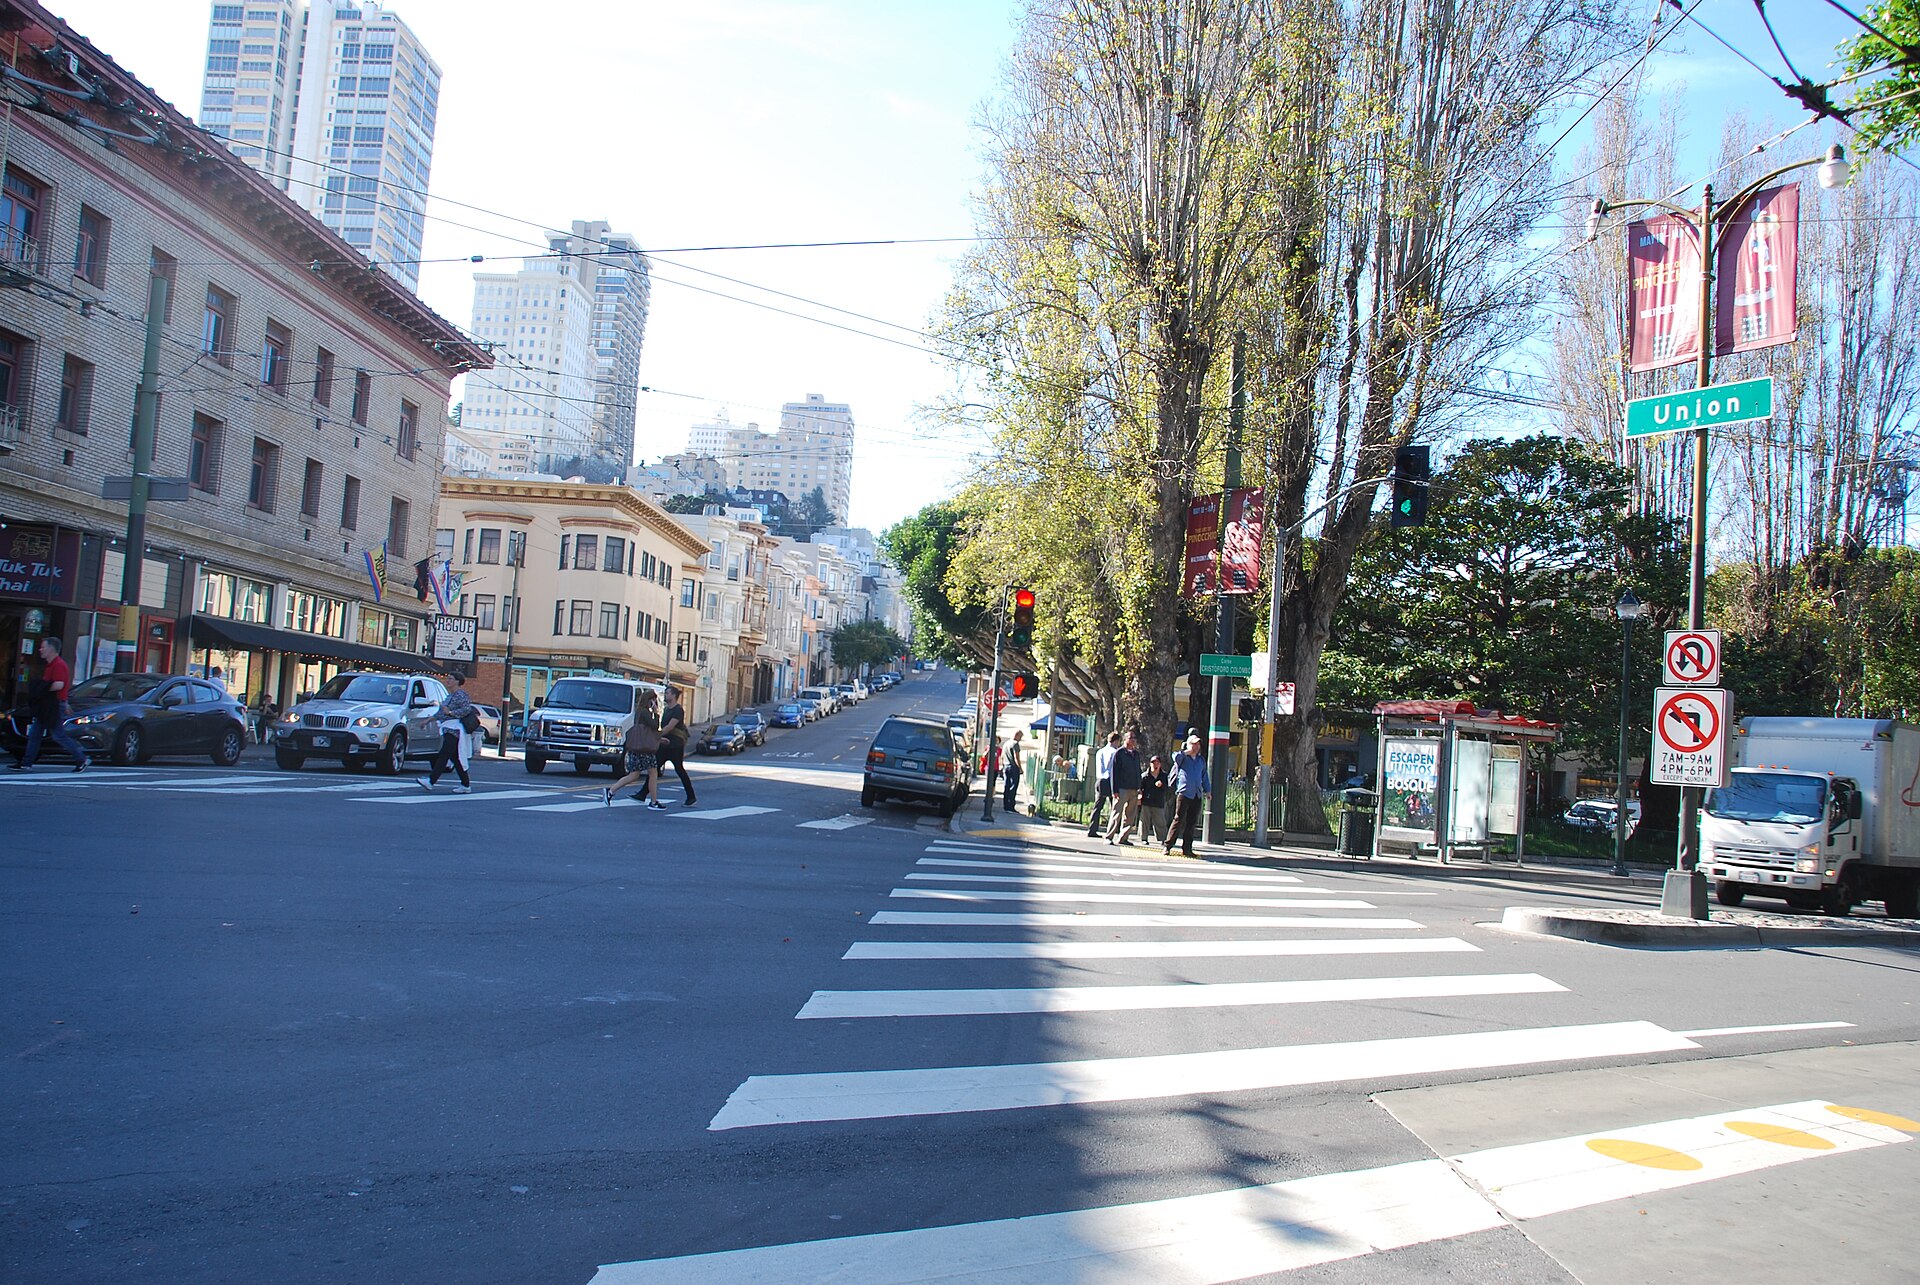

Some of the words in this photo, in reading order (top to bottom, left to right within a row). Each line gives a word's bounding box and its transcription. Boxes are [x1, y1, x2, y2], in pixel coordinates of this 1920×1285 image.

[1653, 397, 1740, 425] Union
[0, 558, 27, 574] Tuk
[31, 562, 63, 578] Tuk
[437, 616, 474, 634] ROGUE
[985, 694, 1007, 704] SP
[1390, 751, 1435, 765] ESCAPEN
[1662, 752, 1712, 764] 7AM-9AM
[1391, 763, 1432, 775] JUNTOS
[1660, 764, 1712, 776] 4PM-6PM
[1386, 777, 1434, 793] BOSQUE
